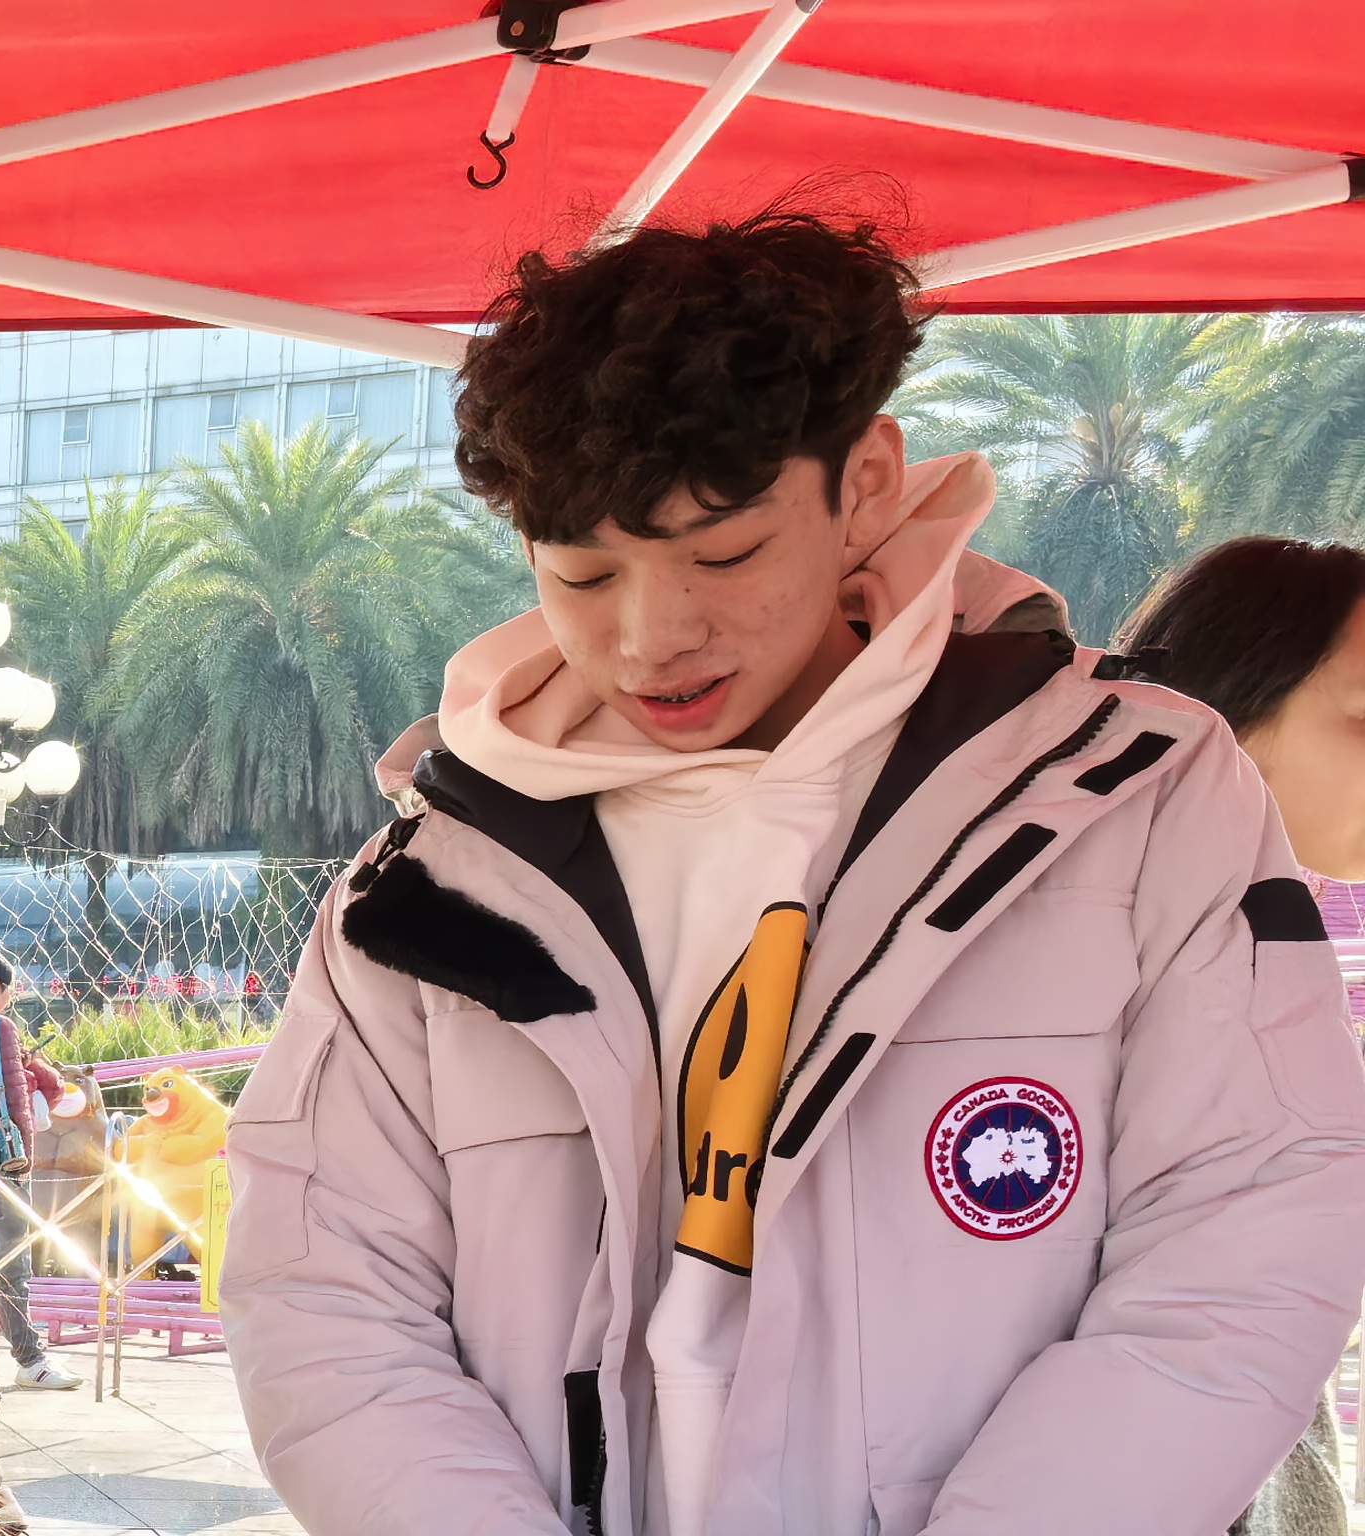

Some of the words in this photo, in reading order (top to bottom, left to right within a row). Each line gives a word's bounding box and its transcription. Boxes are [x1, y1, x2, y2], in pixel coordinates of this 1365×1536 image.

[953, 1087, 1009, 1123] CANADA
[950, 1193, 992, 1227] ARCTIC
[996, 1193, 1059, 1229] PROGRAM
